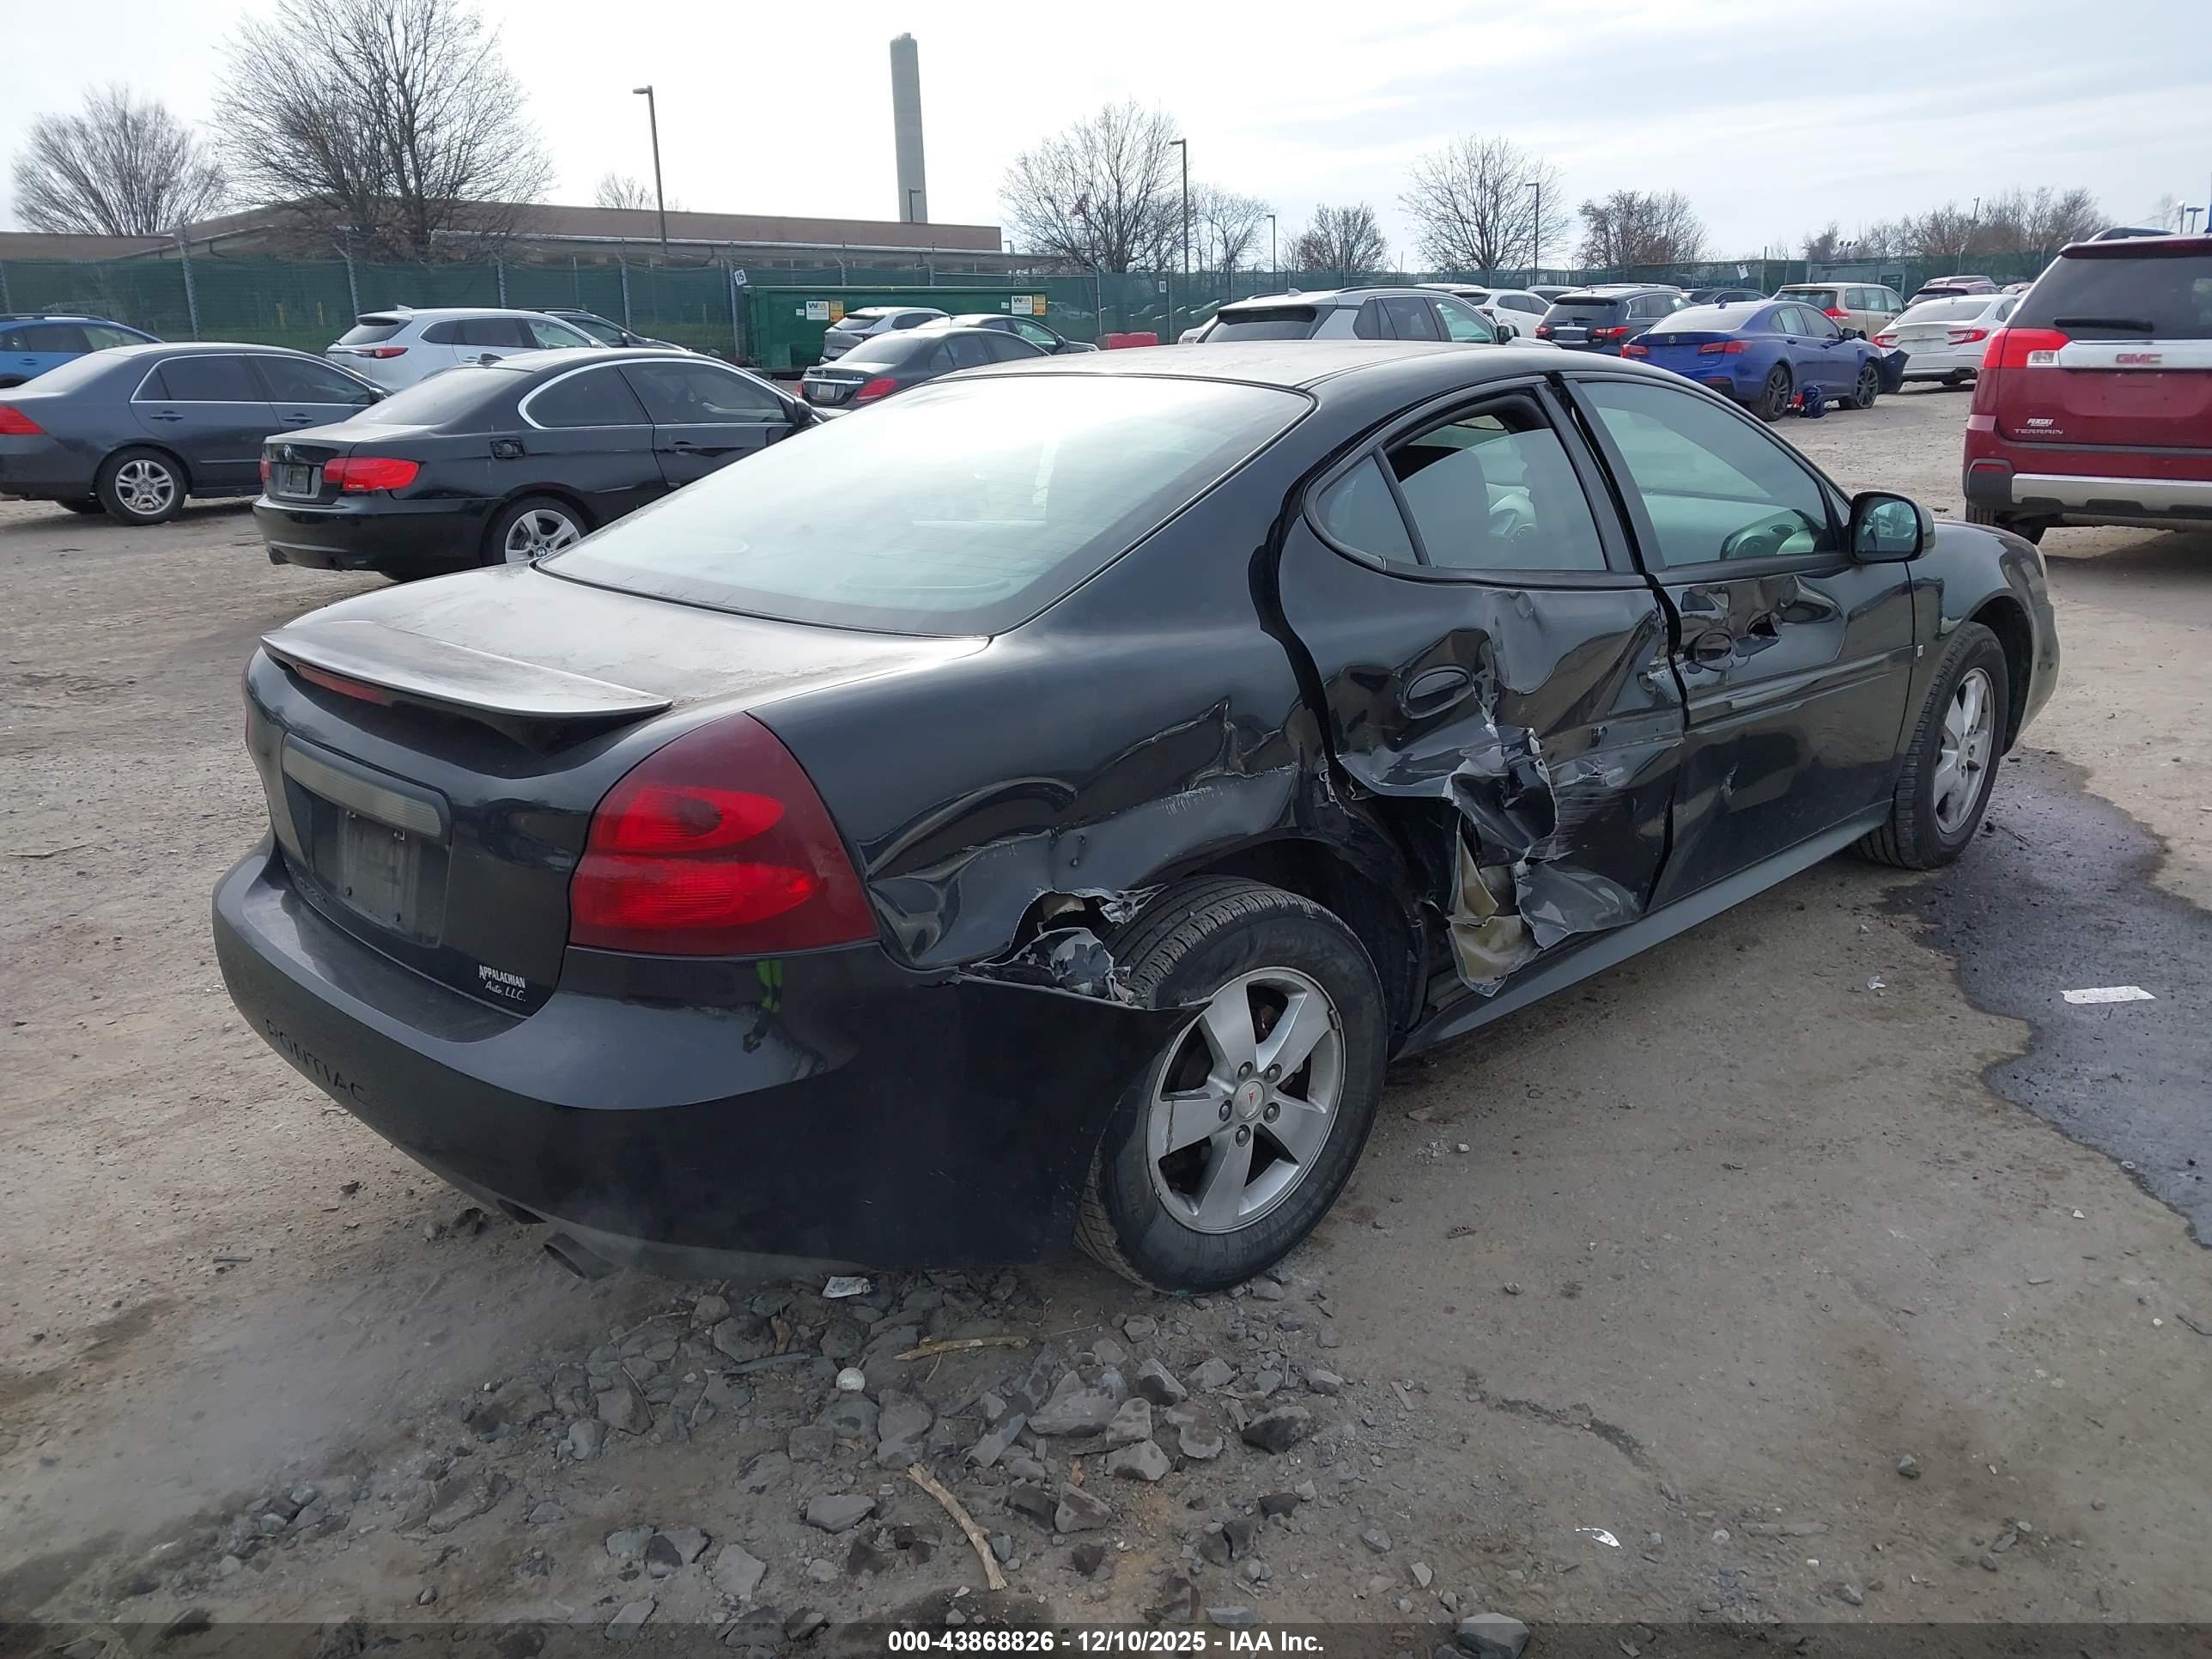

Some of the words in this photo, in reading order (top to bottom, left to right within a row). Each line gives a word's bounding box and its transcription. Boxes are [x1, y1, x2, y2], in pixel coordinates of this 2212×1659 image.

[735, 270, 745, 283] 15
[2116, 353, 2162, 364] GMC
[478, 964, 526, 988] APPALACHIAN
[264, 1018, 369, 1107] PONTIAC
